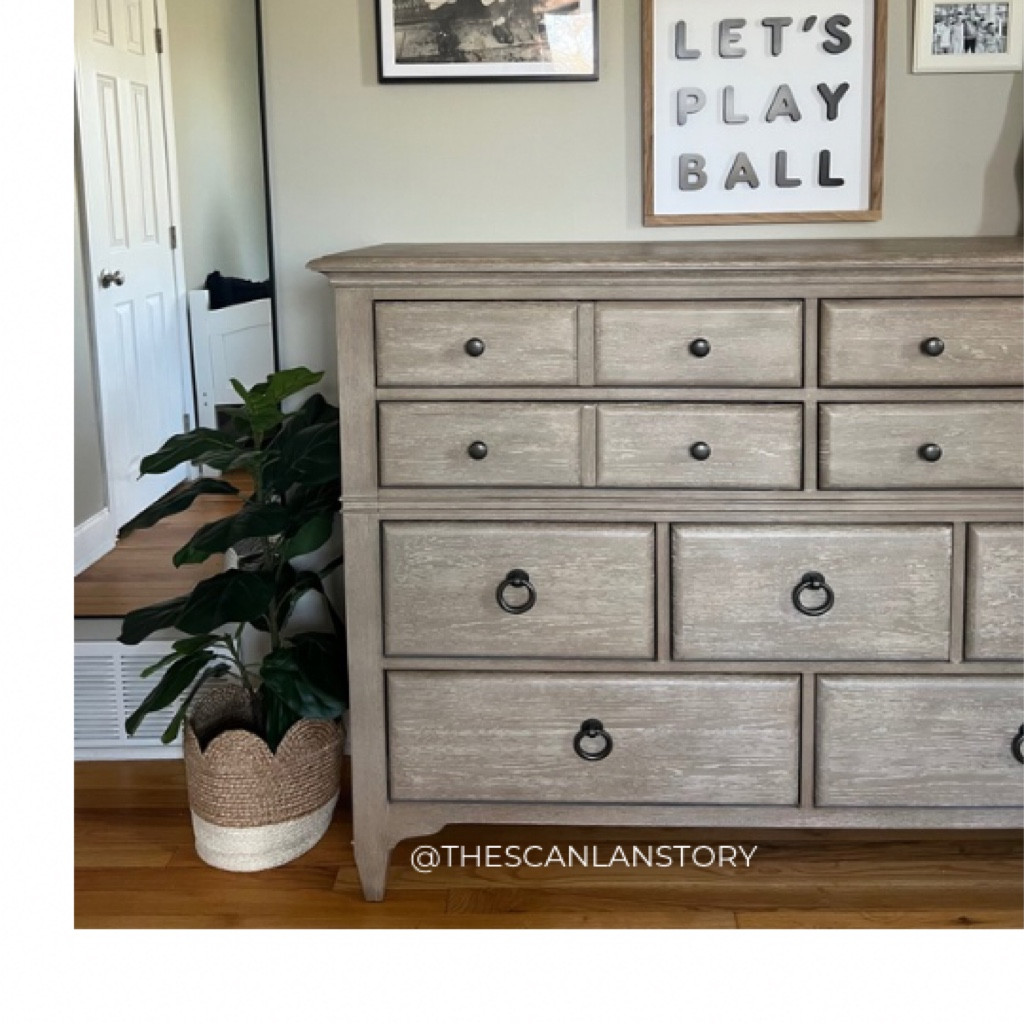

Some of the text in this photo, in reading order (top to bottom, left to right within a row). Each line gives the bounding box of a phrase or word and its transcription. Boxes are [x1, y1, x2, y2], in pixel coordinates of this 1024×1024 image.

[674, 13, 852, 60] LET'S
[676, 82, 850, 127] PLAY
[678, 148, 845, 191] BALL
